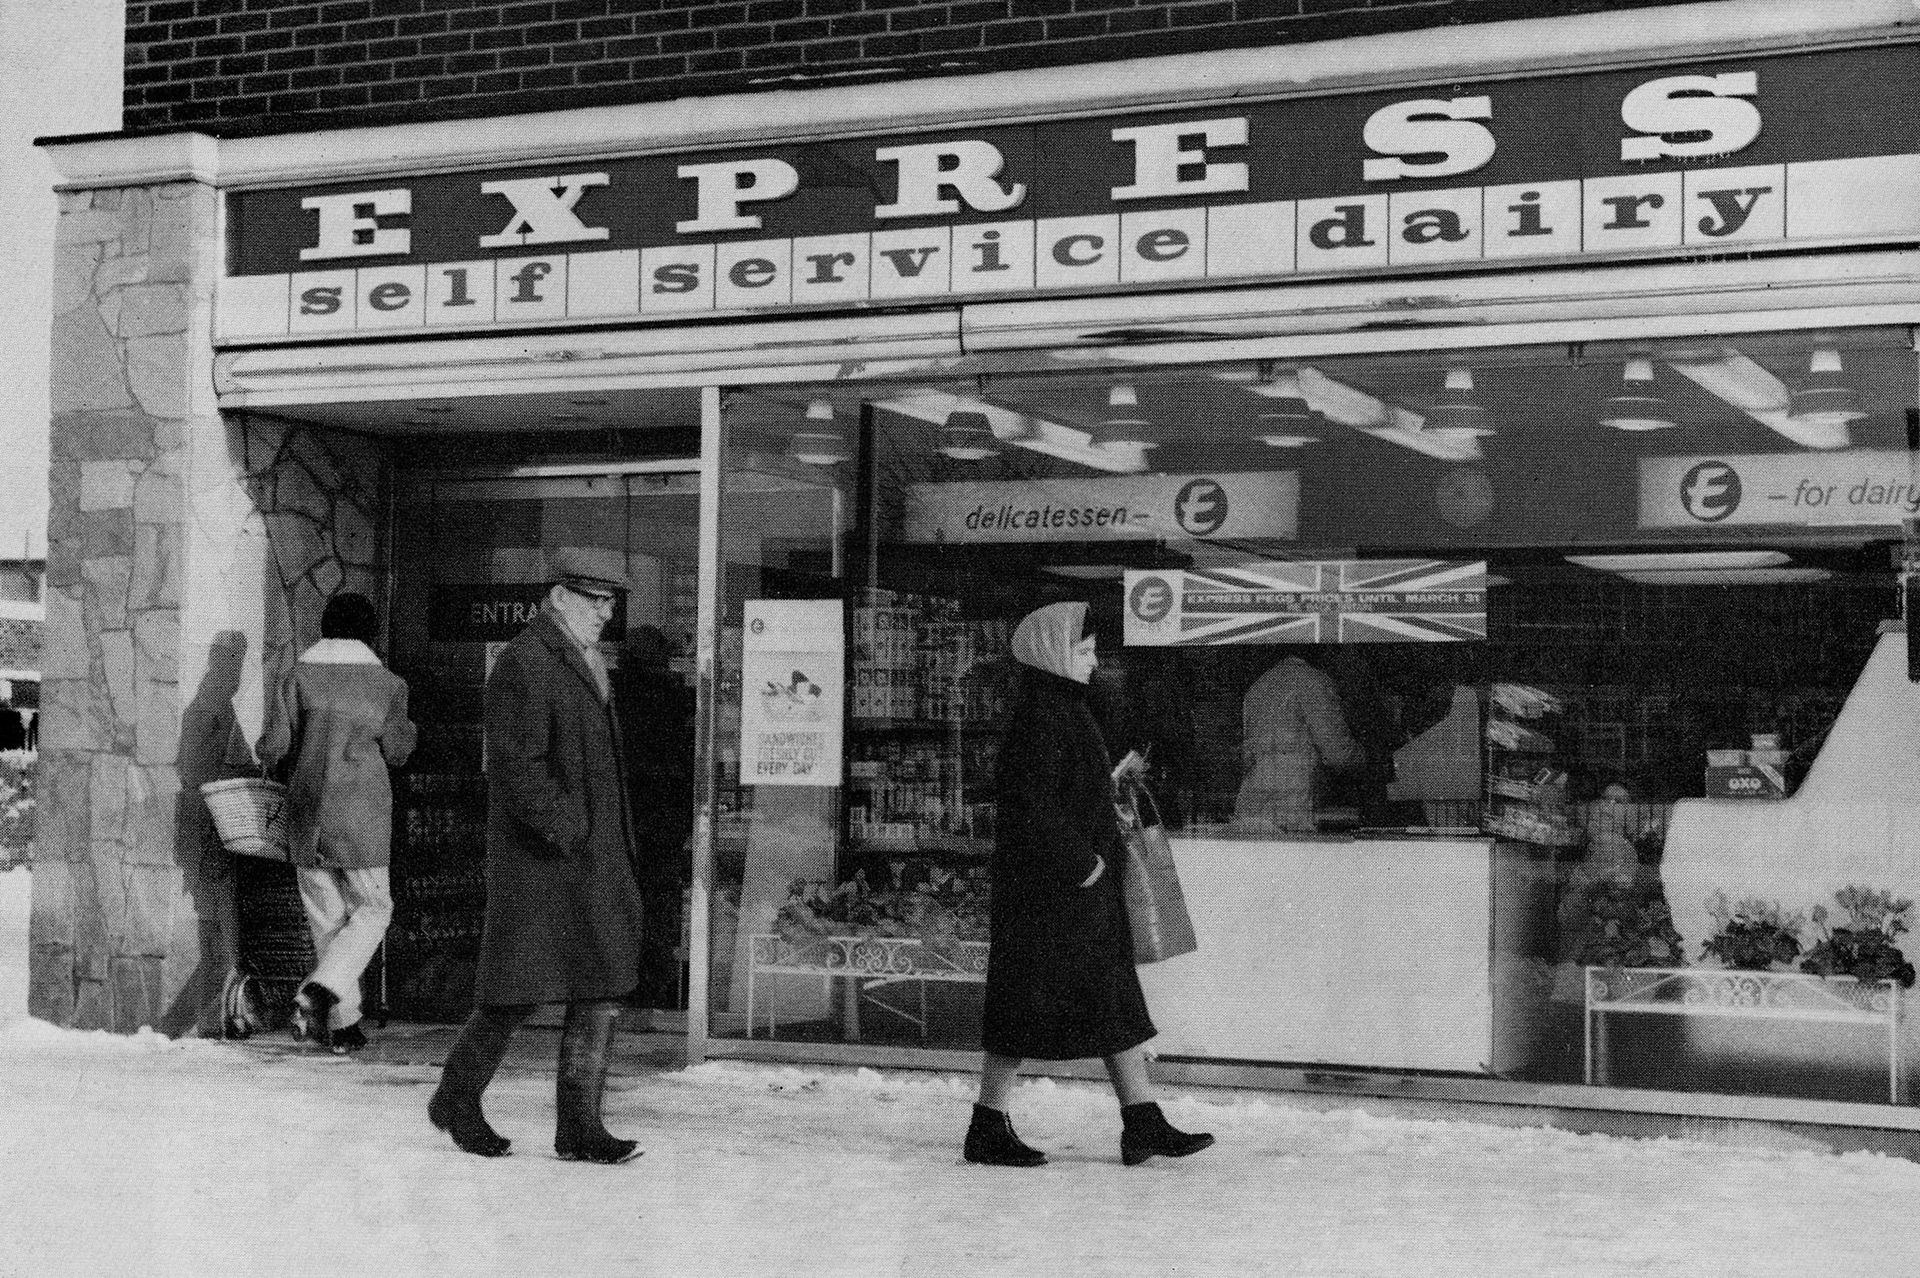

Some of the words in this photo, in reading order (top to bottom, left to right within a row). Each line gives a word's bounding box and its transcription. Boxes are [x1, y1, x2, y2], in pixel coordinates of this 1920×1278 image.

[299, 71, 1763, 262] EXPRESS
[299, 260, 551, 316] self
[653, 227, 1190, 295] service
[1309, 186, 1772, 249] dairy
[1794, 478, 1837, 507] for
[1849, 477, 1920, 514] dairy
[965, 504, 1128, 531] delicatessen
[1187, 594, 1251, 604] EXPRESS
[1300, 593, 1354, 603] PRICES
[1358, 593, 1398, 603] UNTIL
[1405, 593, 1459, 603] MARCH
[472, 601, 538, 624] ENTRA
[757, 761, 788, 775] EVERY
[792, 761, 814, 775] DAY
[1728, 777, 1761, 789] OXO
